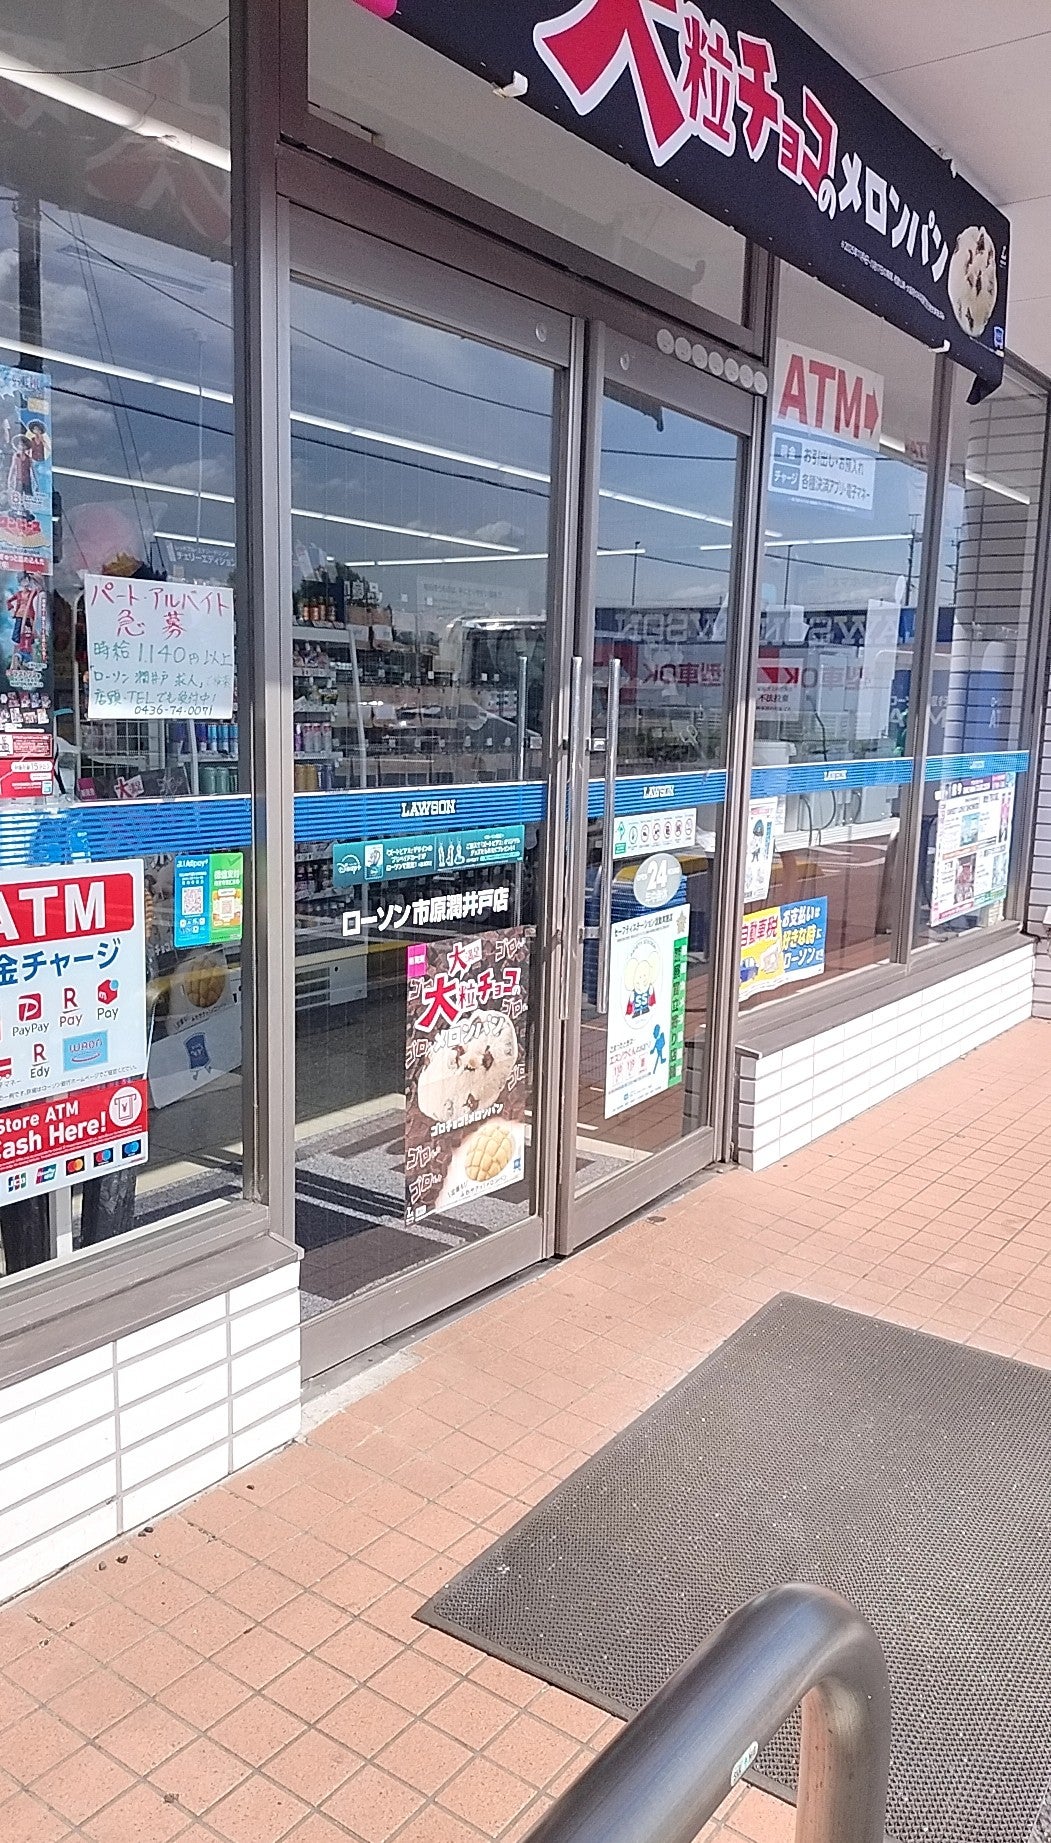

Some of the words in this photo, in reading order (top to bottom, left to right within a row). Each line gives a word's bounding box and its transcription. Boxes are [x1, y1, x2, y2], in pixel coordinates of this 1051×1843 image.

[778, 354, 863, 439] ATM
[774, 470, 798, 486] チャージ
[90, 582, 230, 617] パート・アルバイト
[134, 705, 213, 716] 0436-74-0071
[643, 784, 675, 799] LAWSON
[401, 799, 456, 817] LAWSON
[647, 860, 668, 891] 24
[342, 886, 509, 937] ローソン市原潤井戸店
[782, 905, 821, 928] お支払いは
[415, 967, 521, 1033] 大粒チョコの
[634, 993, 648, 1008] SS
[59, 1014, 83, 1028] Pay
[97, 1007, 119, 1020] Pay
[12, 1022, 50, 1037] PayPay
[433, 1013, 505, 1052] メロンパン
[30, 1065, 50, 1079] Edy
[45, 1101, 79, 1123] ATM
[0, 1129, 42, 1160] ash
[49, 1113, 107, 1147] Here!
